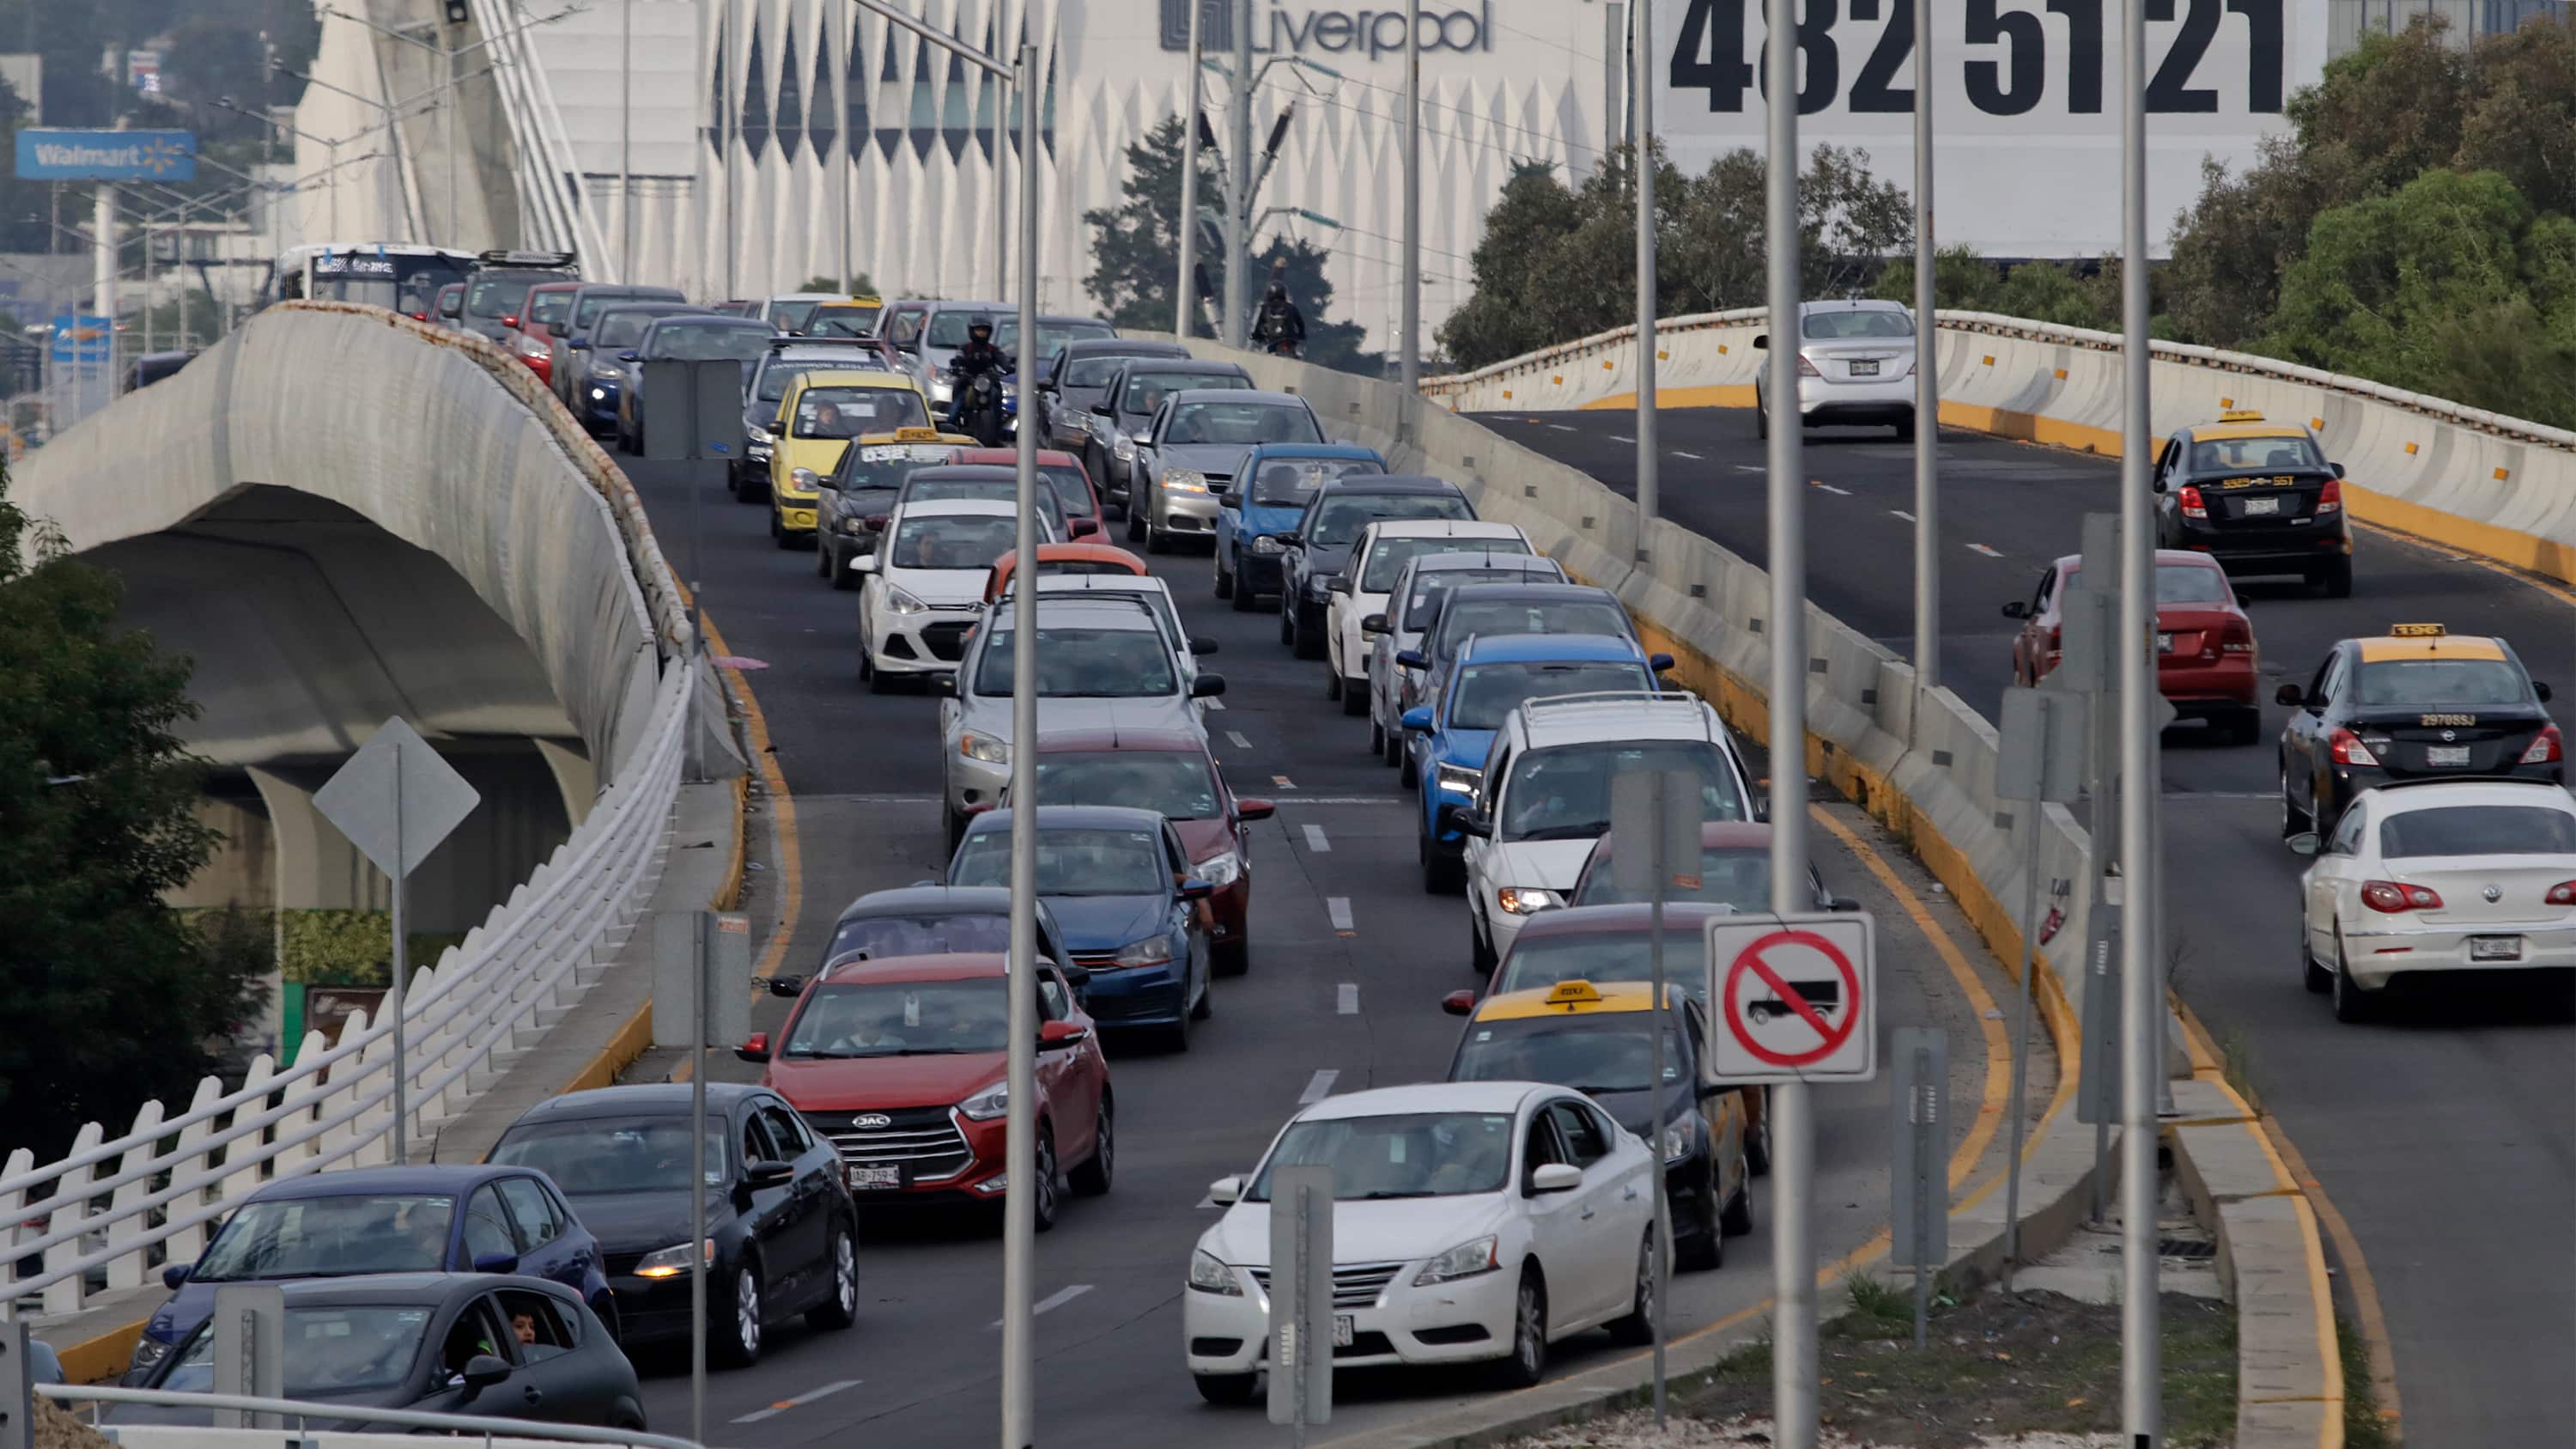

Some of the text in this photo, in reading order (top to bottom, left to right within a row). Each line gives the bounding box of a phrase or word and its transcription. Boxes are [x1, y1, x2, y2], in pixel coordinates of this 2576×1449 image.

[1964, 0, 2102, 115] 51
[2144, 0, 2283, 113] 21
[35, 143, 139, 166] Walmart
